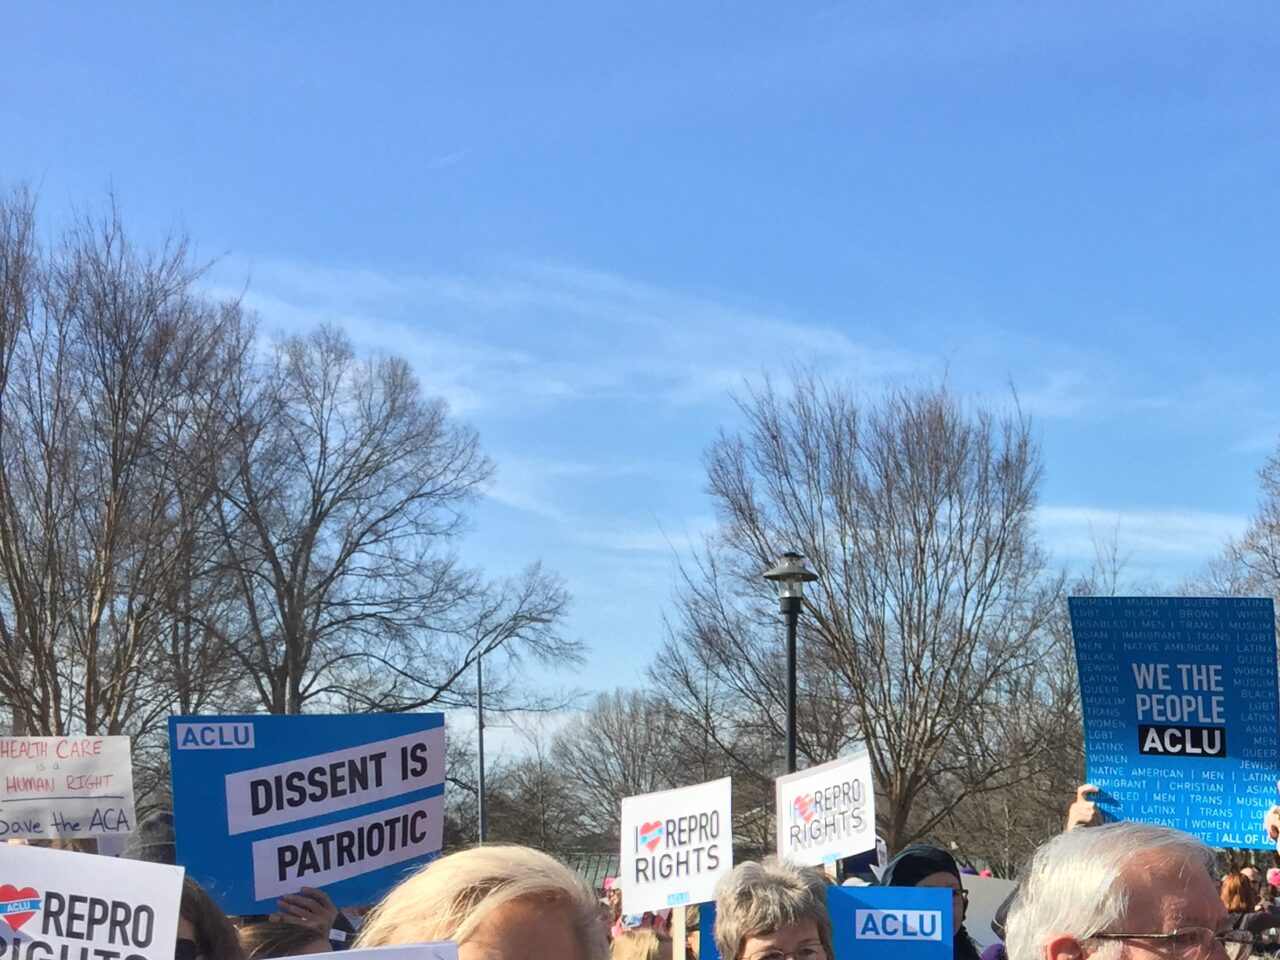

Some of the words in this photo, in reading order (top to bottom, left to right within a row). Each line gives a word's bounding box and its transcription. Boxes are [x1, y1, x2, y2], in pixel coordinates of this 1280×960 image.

[1132, 663, 1172, 690] WE
[1177, 664, 1224, 692] THE
[1136, 694, 1226, 724] PEOPLE
[182, 724, 249, 747] ACLU
[1090, 743, 1123, 751] LATINX
[1143, 728, 1221, 755] ACLU
[1, 741, 47, 758] HEALTH
[56, 740, 103, 759] CARE
[1090, 754, 1128, 764] WOMEN
[1243, 749, 1277, 758] QUEER
[1091, 767, 1124, 776] NATIVE
[1131, 768, 1184, 778] AMERICAN
[1202, 771, 1224, 780] MEN
[1243, 773, 1277, 782] LATINX
[1239, 760, 1277, 770] JEWISH
[250, 752, 386, 816] DISSENT
[400, 743, 427, 780] IS
[1091, 779, 1147, 789] IMMIGRANT
[1170, 782, 1224, 792] CHRISTIAN
[1247, 785, 1277, 794] ASIAN
[815, 779, 860, 813] REPRO
[1153, 793, 1176, 802] MEN
[1190, 795, 1222, 804] TRANS
[51, 812, 82, 831] the
[89, 808, 130, 832] ACA
[1098, 803, 1124, 813] UEER
[1141, 805, 1176, 815] LATINX
[1200, 808, 1233, 817] TRANS
[636, 826, 638, 853] I
[666, 810, 719, 848] REPRO
[790, 807, 862, 846] RIGHTS
[1192, 820, 1230, 830] WOMEN
[1242, 823, 1265, 831] LATI
[277, 810, 427, 881] PATRIOTIC
[1222, 833, 1242, 843] ALL
[1245, 834, 1258, 844] OF
[1262, 836, 1276, 845] US
[636, 845, 719, 883] RIGHTS
[7, 902, 30, 913] ACLU
[41, 891, 154, 948] REPRO
[861, 913, 936, 937] ACLU
